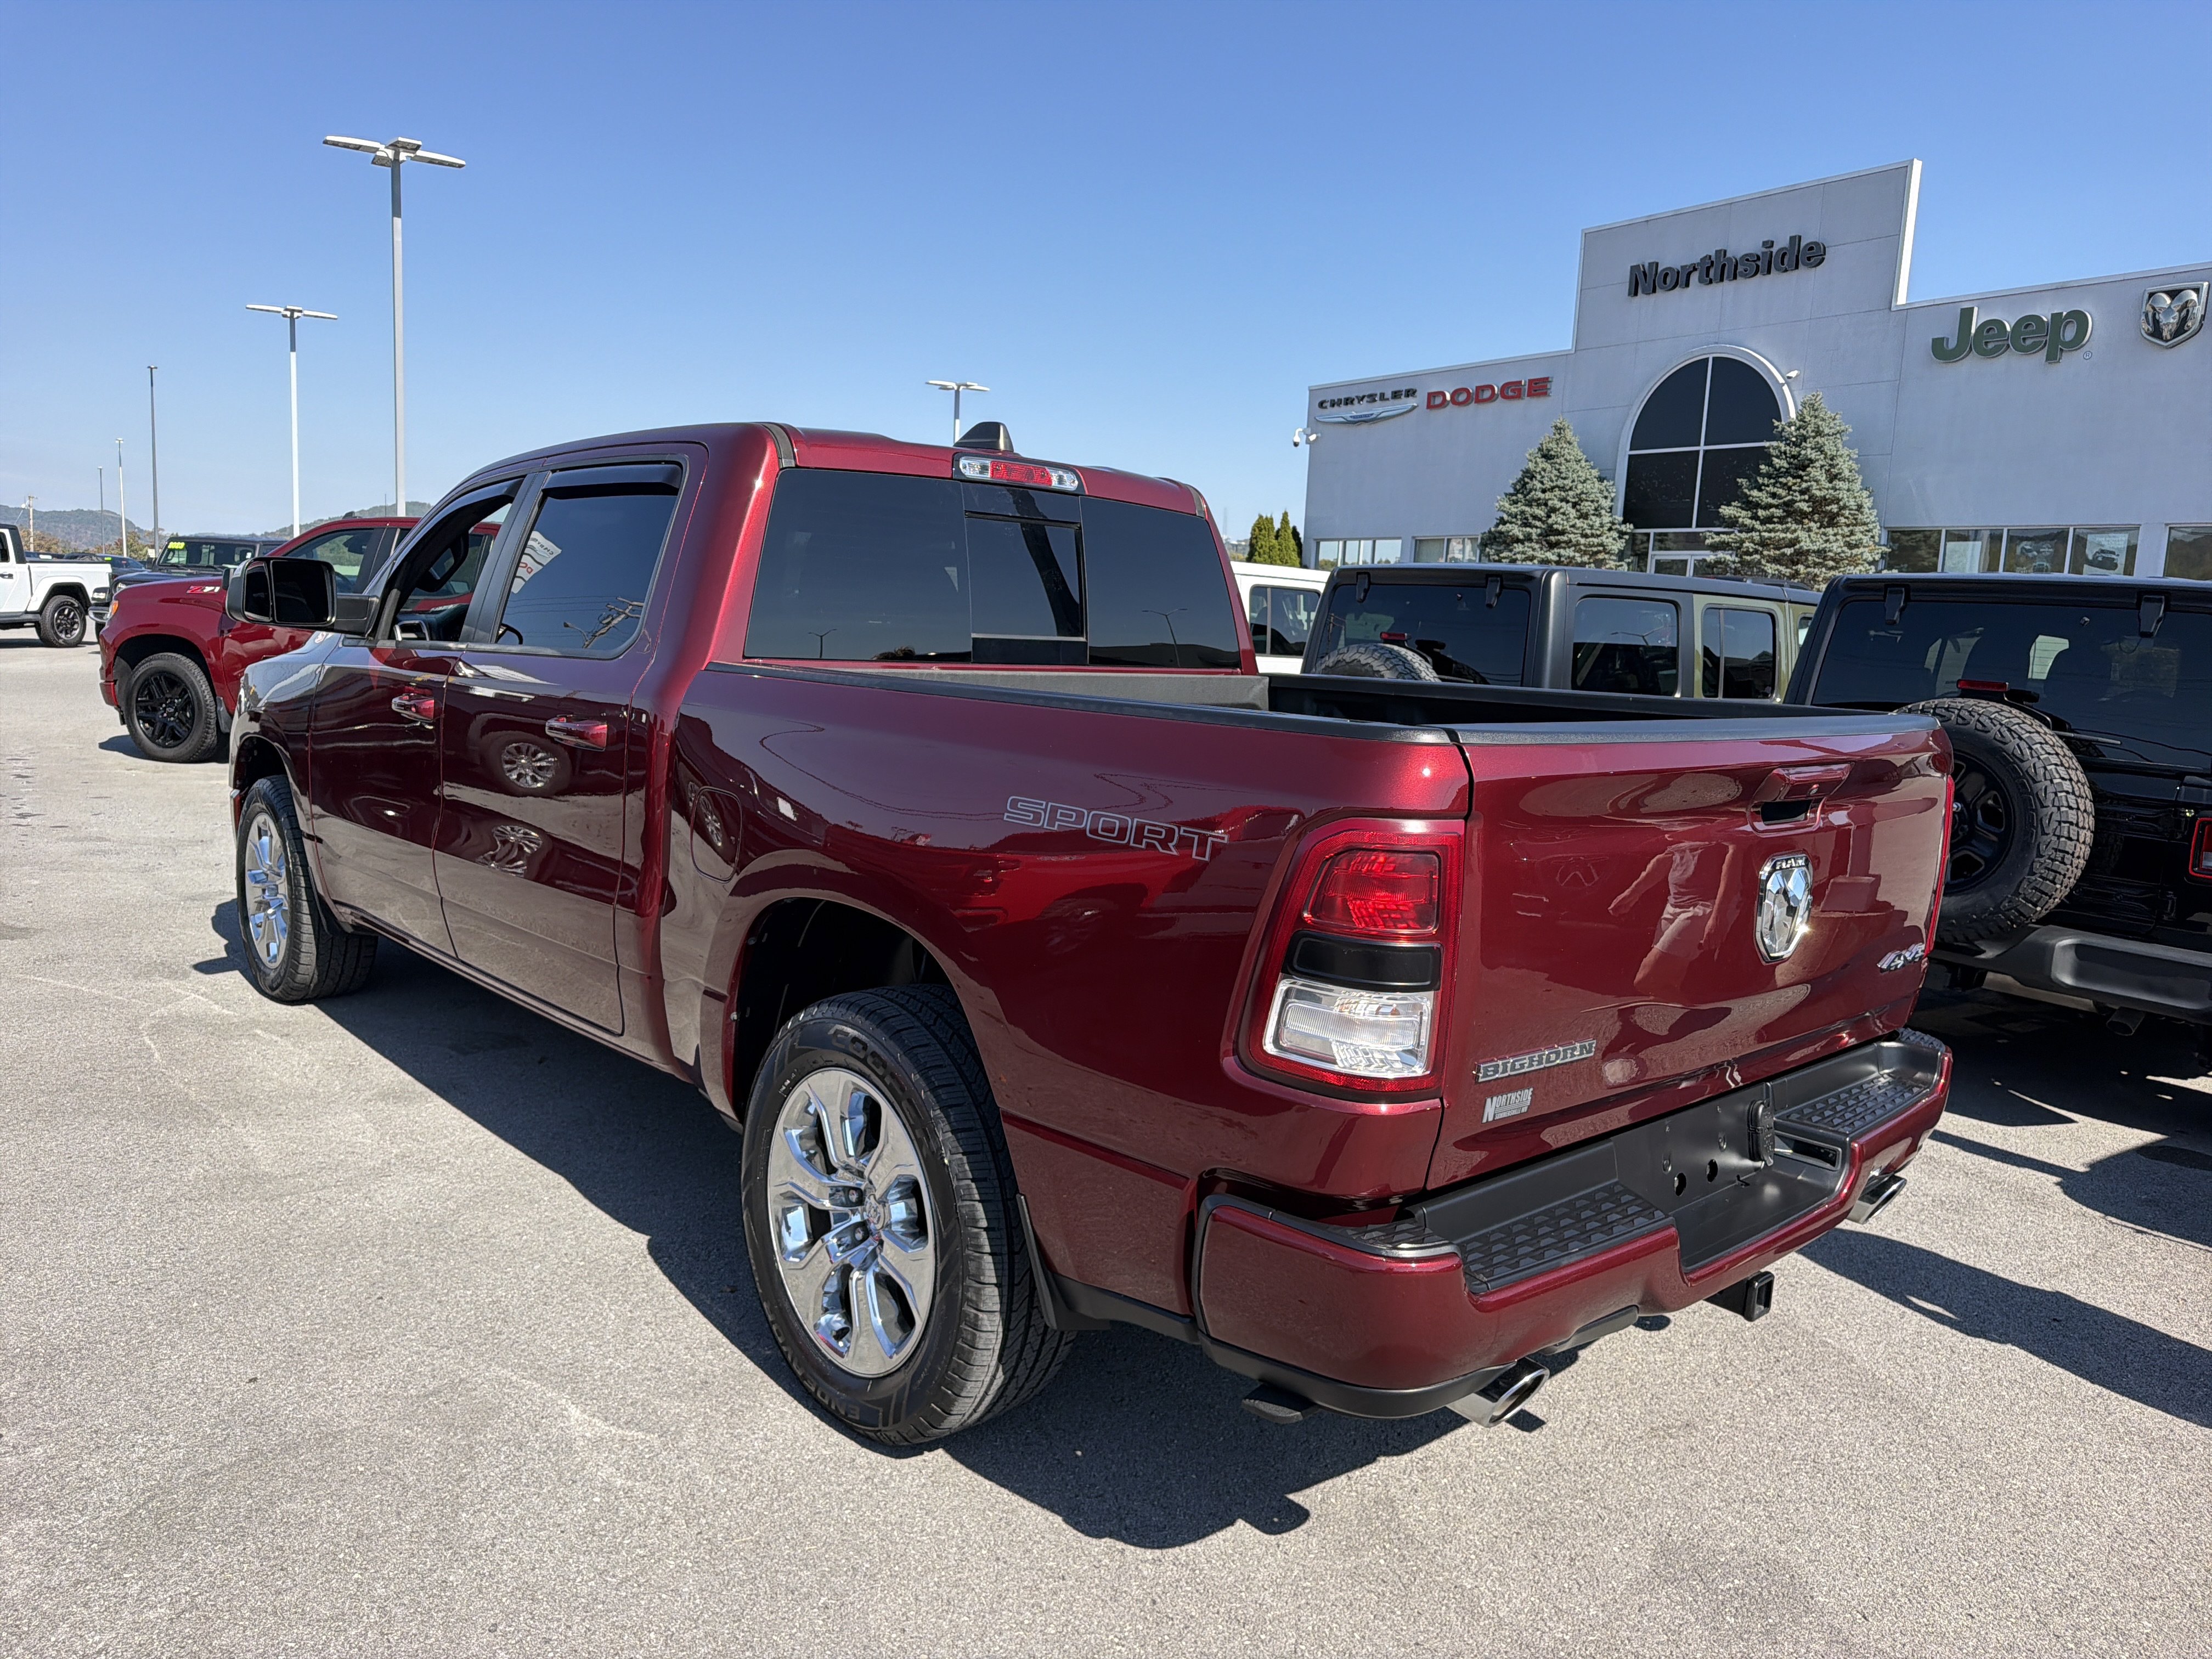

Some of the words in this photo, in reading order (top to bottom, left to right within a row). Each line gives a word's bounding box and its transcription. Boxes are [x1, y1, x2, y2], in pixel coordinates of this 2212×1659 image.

[1628, 235, 1826, 297] Northside
[1931, 306, 2092, 363] Jeep
[1318, 388, 1418, 409] CHRYSLER
[1426, 377, 1552, 409] DODGE
[187, 585, 220, 594] Z71
[1003, 795, 1229, 862] SPORT
[1775, 857, 1805, 870] RAM
[1477, 1037, 1596, 1084] BIGHORN
[1482, 1087, 1533, 1124] NORTHSIDE
